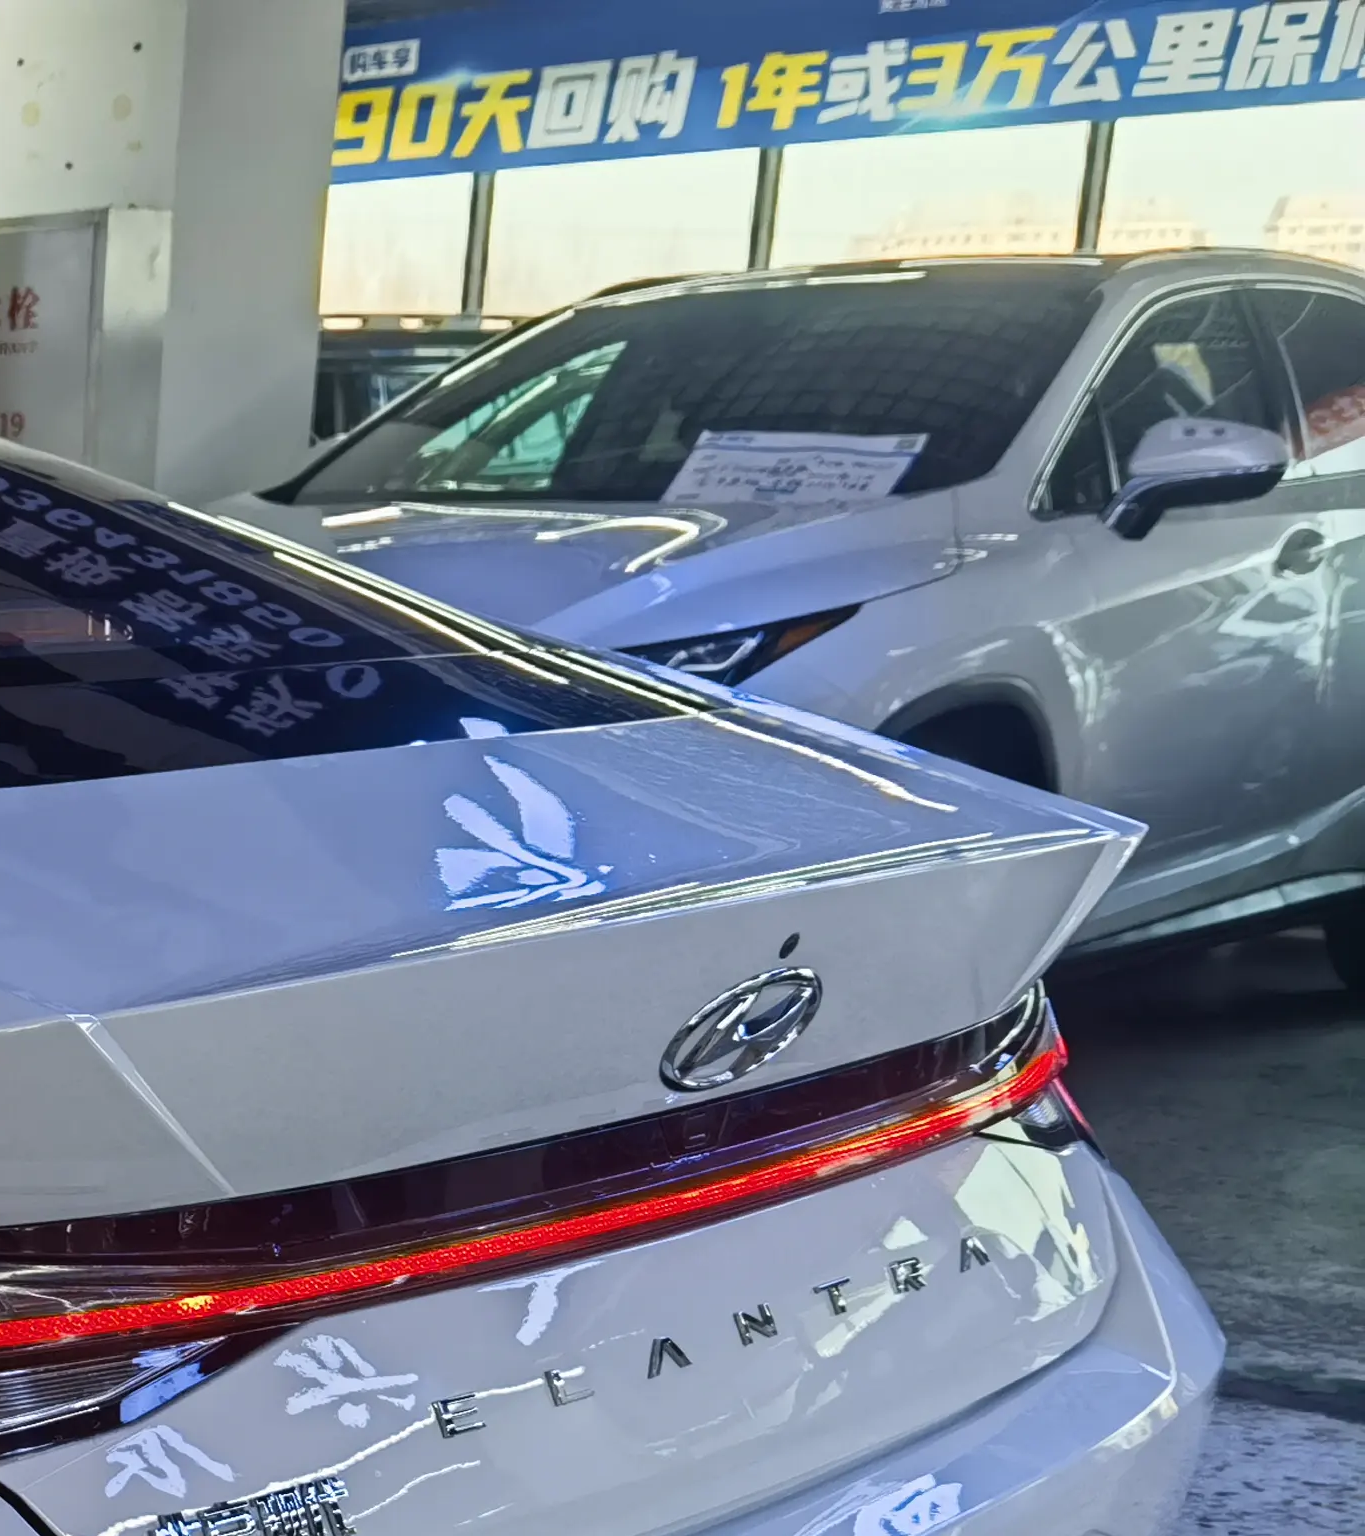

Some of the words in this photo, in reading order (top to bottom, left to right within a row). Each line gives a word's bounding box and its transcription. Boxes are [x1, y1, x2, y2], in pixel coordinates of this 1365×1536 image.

[330, 50, 698, 167] 90天回购
[433, 1235, 990, 1439] ELANTRA
